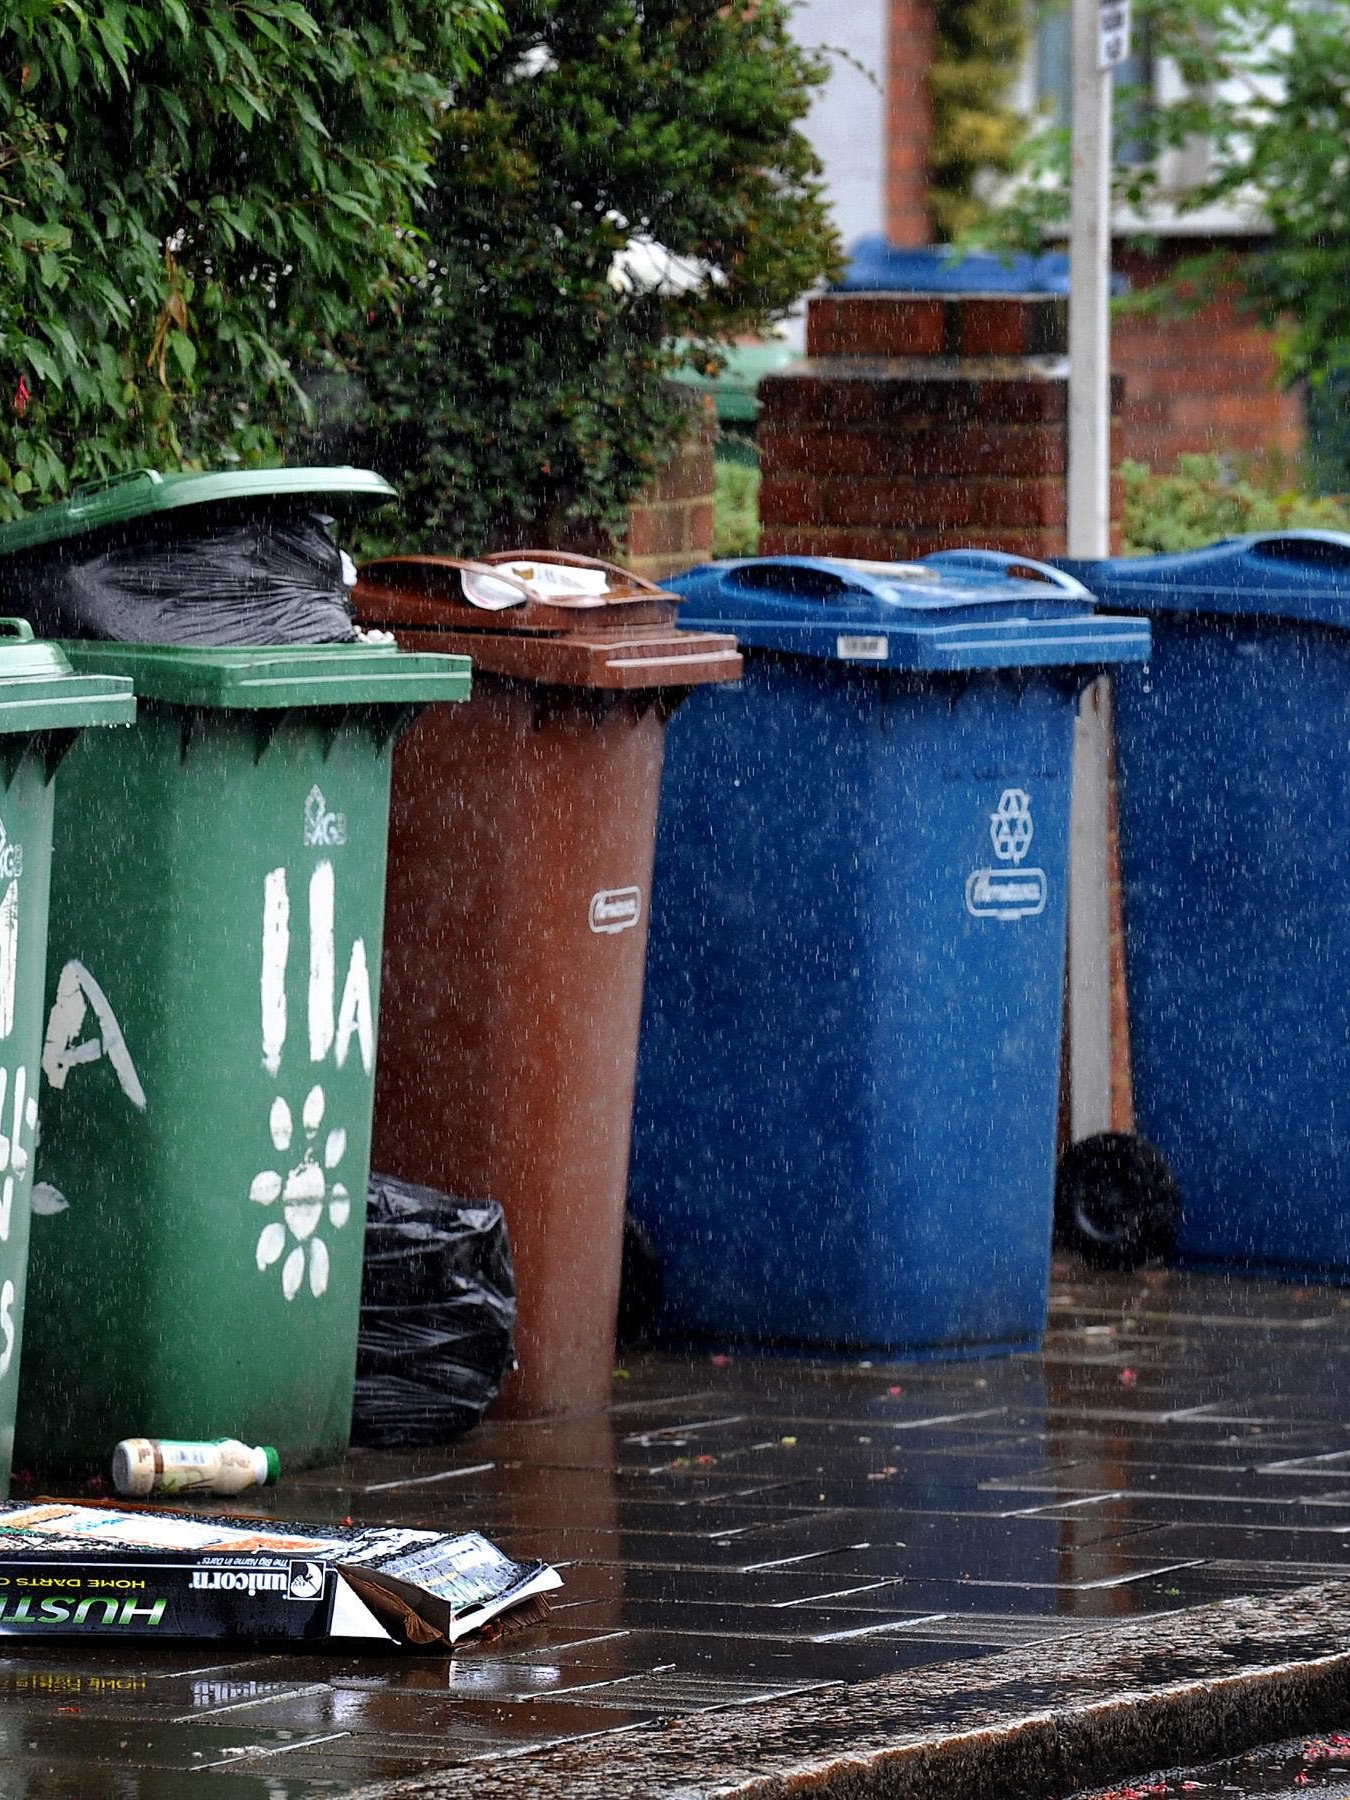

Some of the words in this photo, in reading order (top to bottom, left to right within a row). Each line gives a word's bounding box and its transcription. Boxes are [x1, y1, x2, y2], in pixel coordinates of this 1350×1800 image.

[233, 1557, 259, 1567] Name
[258, 1557, 273, 1567] Big
[16, 1577, 81, 1589] DARTS
[88, 1578, 145, 1589] HOME
[192, 1571, 288, 1597] unicorn
